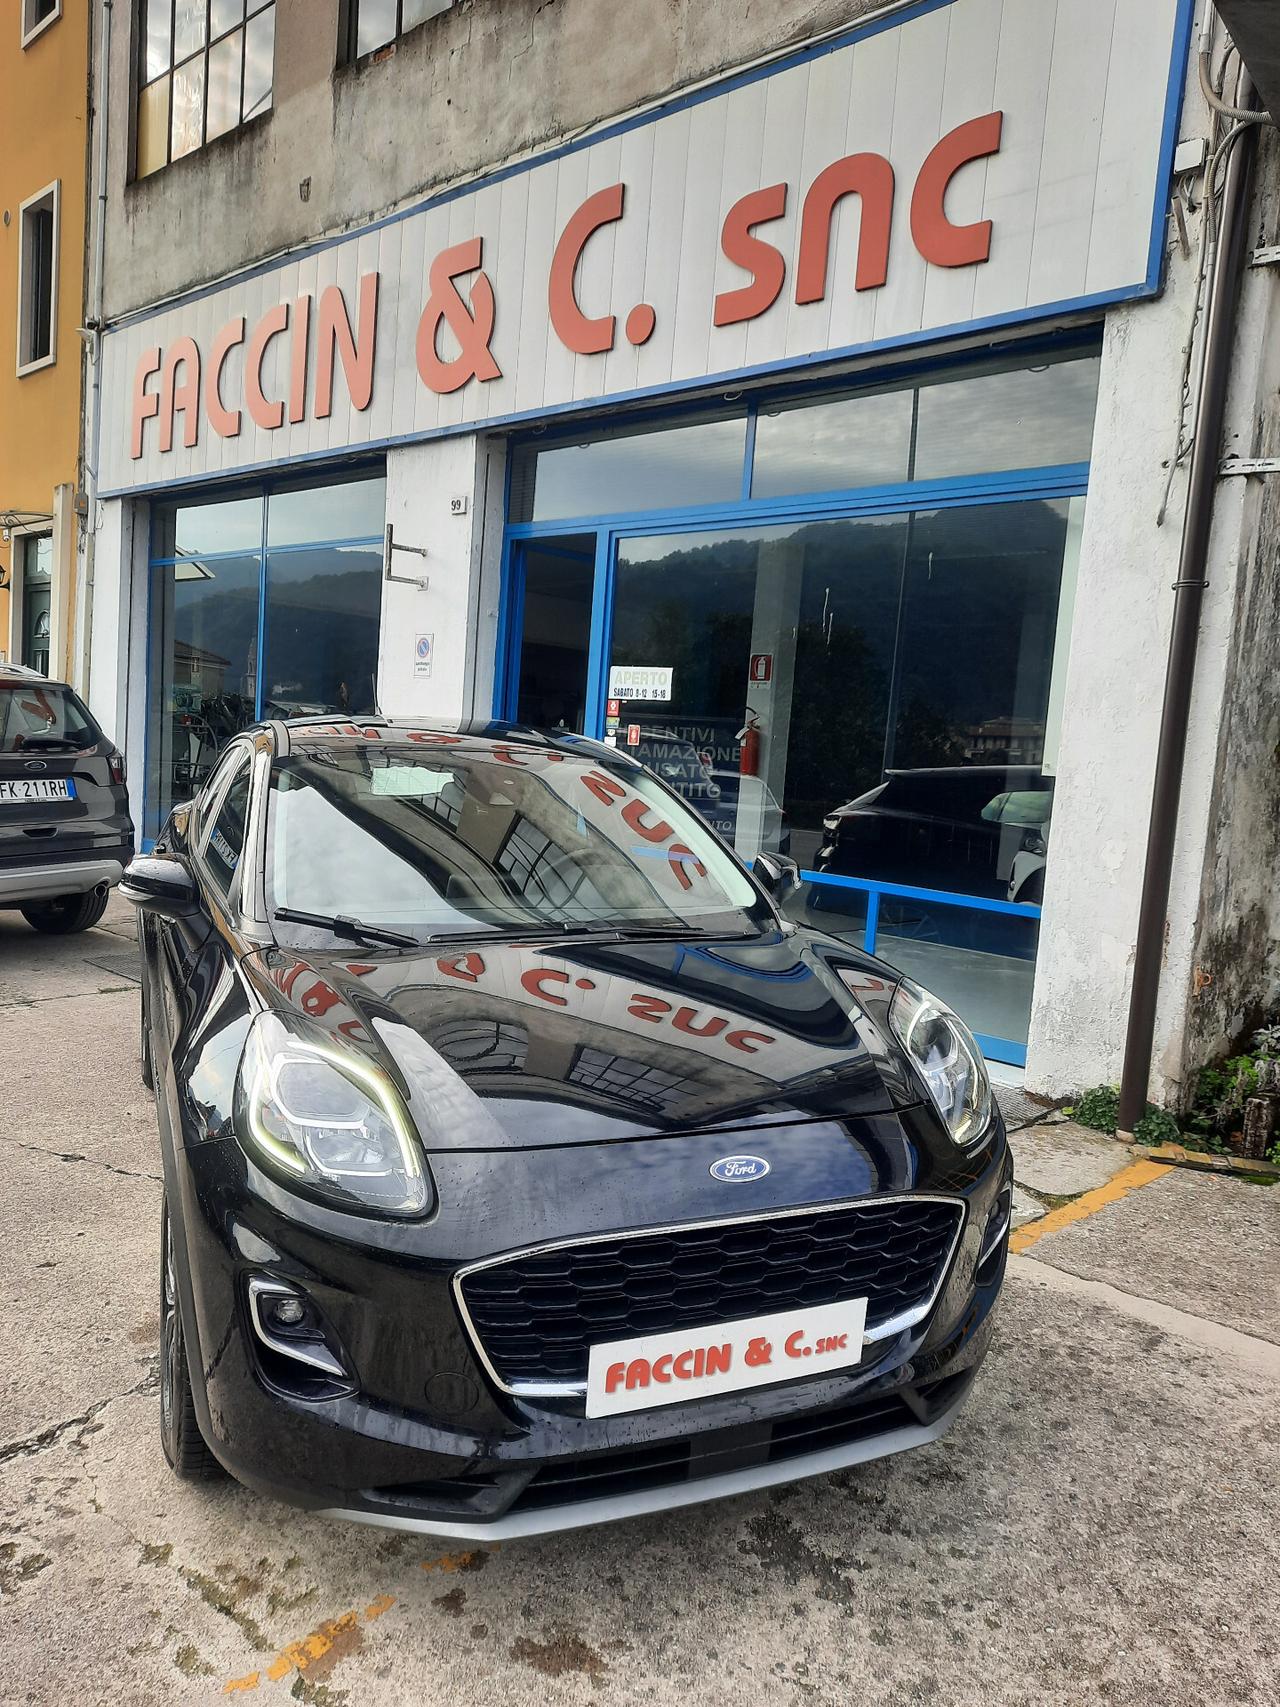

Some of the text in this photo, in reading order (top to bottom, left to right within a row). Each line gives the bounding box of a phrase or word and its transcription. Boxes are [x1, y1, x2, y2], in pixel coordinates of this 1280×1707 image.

[131, 271, 379, 459] FACCIN
[416, 236, 502, 394] &
[548, 182, 656, 355] C.
[451, 500, 461, 511] 99
[614, 671, 668, 686] APERTO
[614, 687, 633, 697] SABATO
[725, 1161, 757, 1177] Ford
[605, 1343, 732, 1393] FACCIN
[744, 1336, 772, 1367] &
